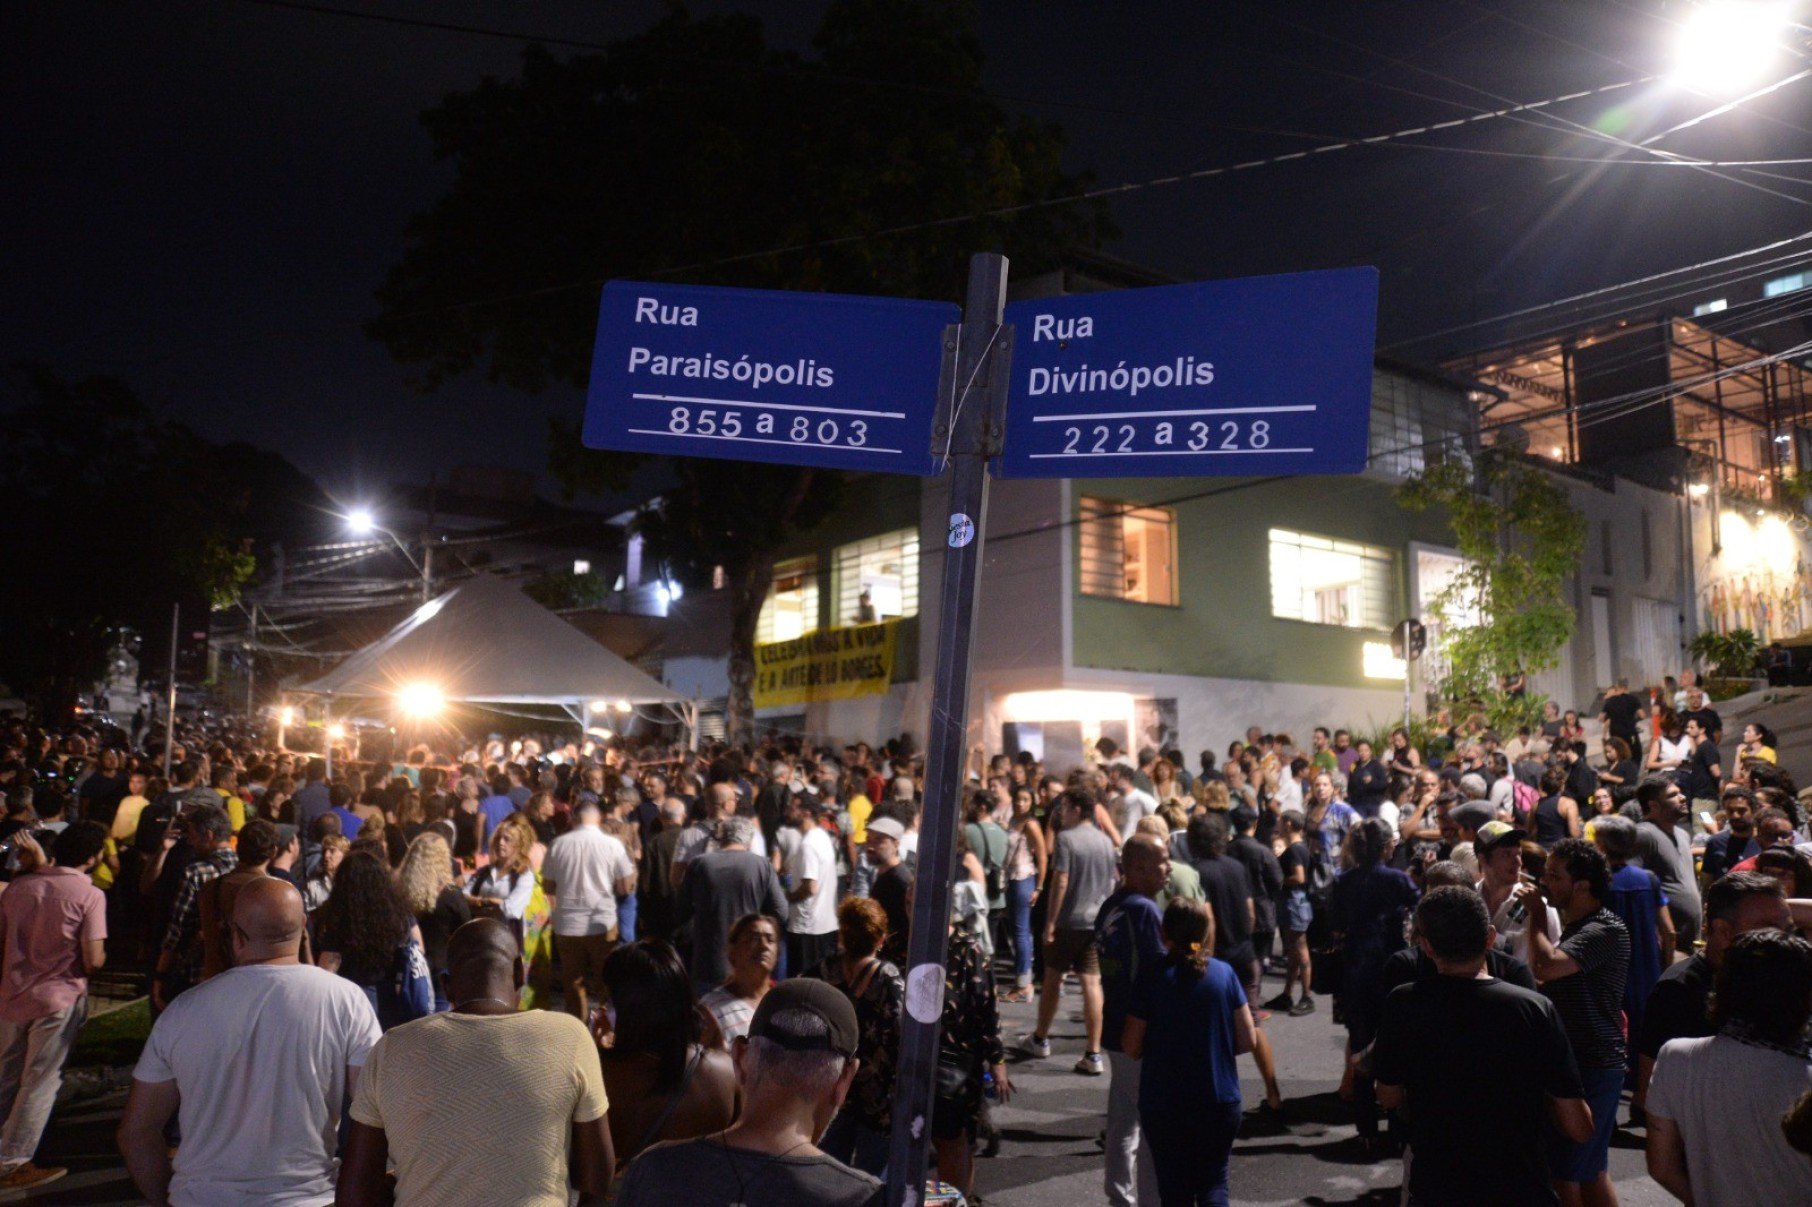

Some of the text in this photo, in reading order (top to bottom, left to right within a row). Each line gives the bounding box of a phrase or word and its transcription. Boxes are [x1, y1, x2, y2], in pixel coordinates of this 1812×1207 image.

[634, 297, 699, 326] Rua
[1033, 314, 1094, 342] Rua
[628, 347, 835, 389] Paraisópolis
[1028, 356, 1215, 396] Divinópolis
[668, 407, 868, 447] 855 a 803
[1062, 420, 1270, 454] 222 a 328
